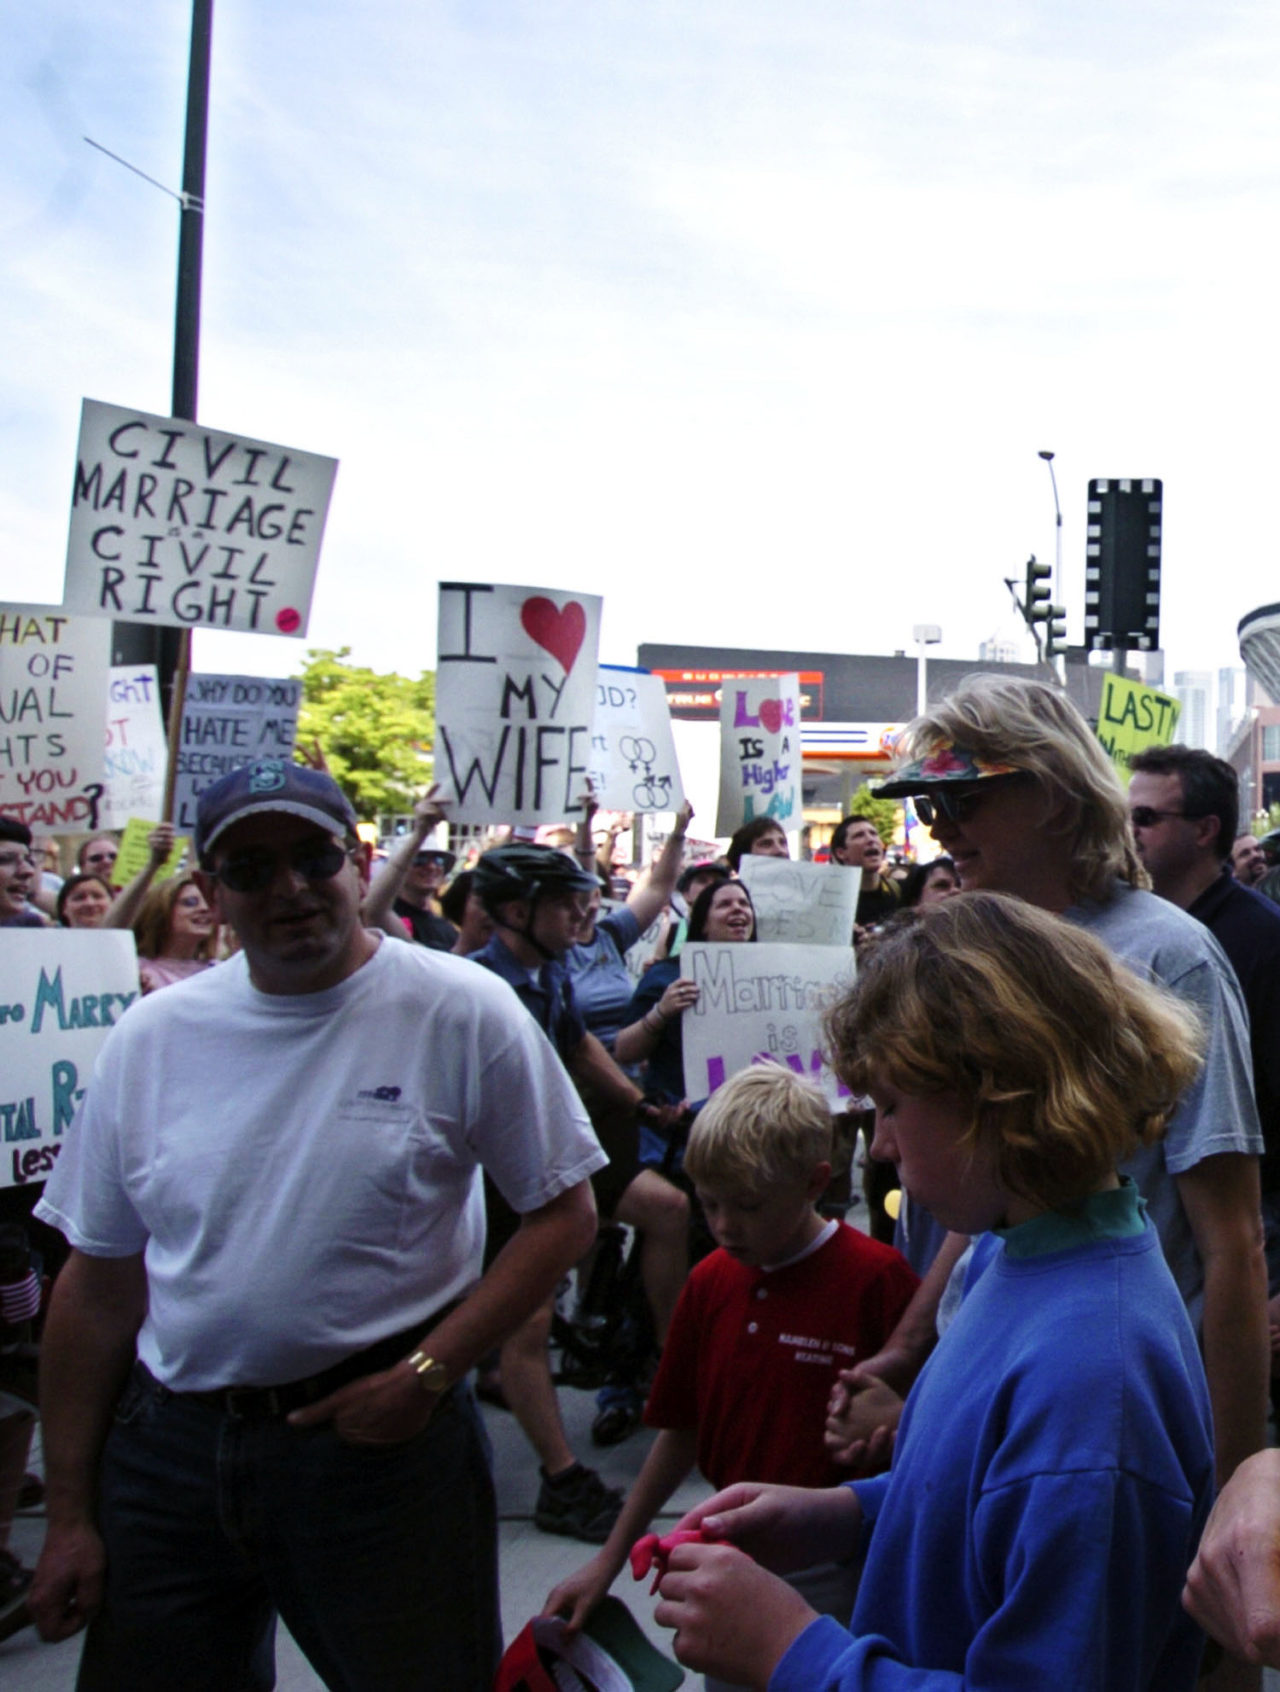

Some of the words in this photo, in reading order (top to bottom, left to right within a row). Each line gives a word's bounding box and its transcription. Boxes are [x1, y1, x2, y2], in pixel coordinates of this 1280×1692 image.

[109, 421, 294, 493] CIVIL
[73, 460, 314, 546] MARRIAGE
[91, 526, 276, 587] CIVIL
[100, 566, 269, 630] RIGHT
[439, 582, 497, 664] I
[27, 652, 75, 681] OF
[233, 683, 263, 704] DO
[265, 684, 297, 708] YOU
[500, 672, 570, 720] MY
[184, 715, 249, 746] HATE
[257, 718, 297, 746] ME
[739, 737, 764, 761] IS
[781, 736, 790, 754] A
[17, 768, 77, 795] YOU
[439, 724, 588, 814] WIFE
[767, 1023, 798, 1053] is
[0, 1097, 42, 1142] TAL
